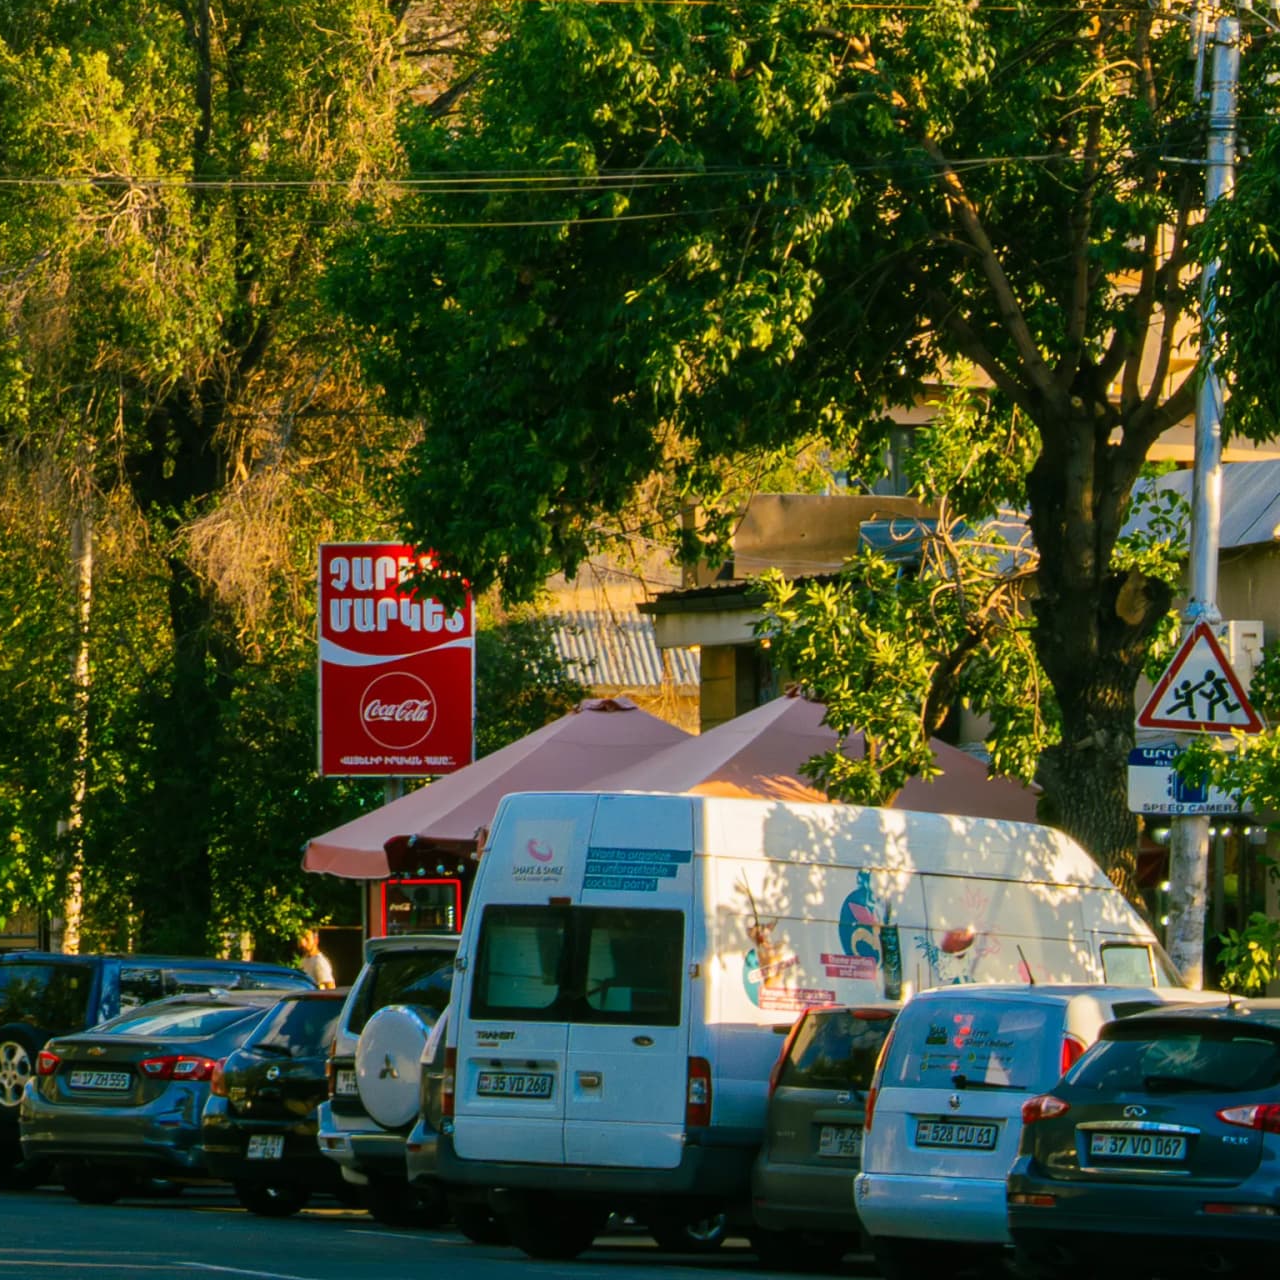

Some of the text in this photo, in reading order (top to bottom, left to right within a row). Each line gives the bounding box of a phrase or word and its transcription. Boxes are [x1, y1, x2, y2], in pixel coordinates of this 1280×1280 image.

[1143, 803, 1240, 813] SPEED CAMERA
[586, 878, 621, 888] cocktail
[493, 1076, 506, 1090] 35
[931, 1126, 953, 1141] 528
[1109, 1135, 1127, 1153] 37
[1155, 1136, 1181, 1156] 067
